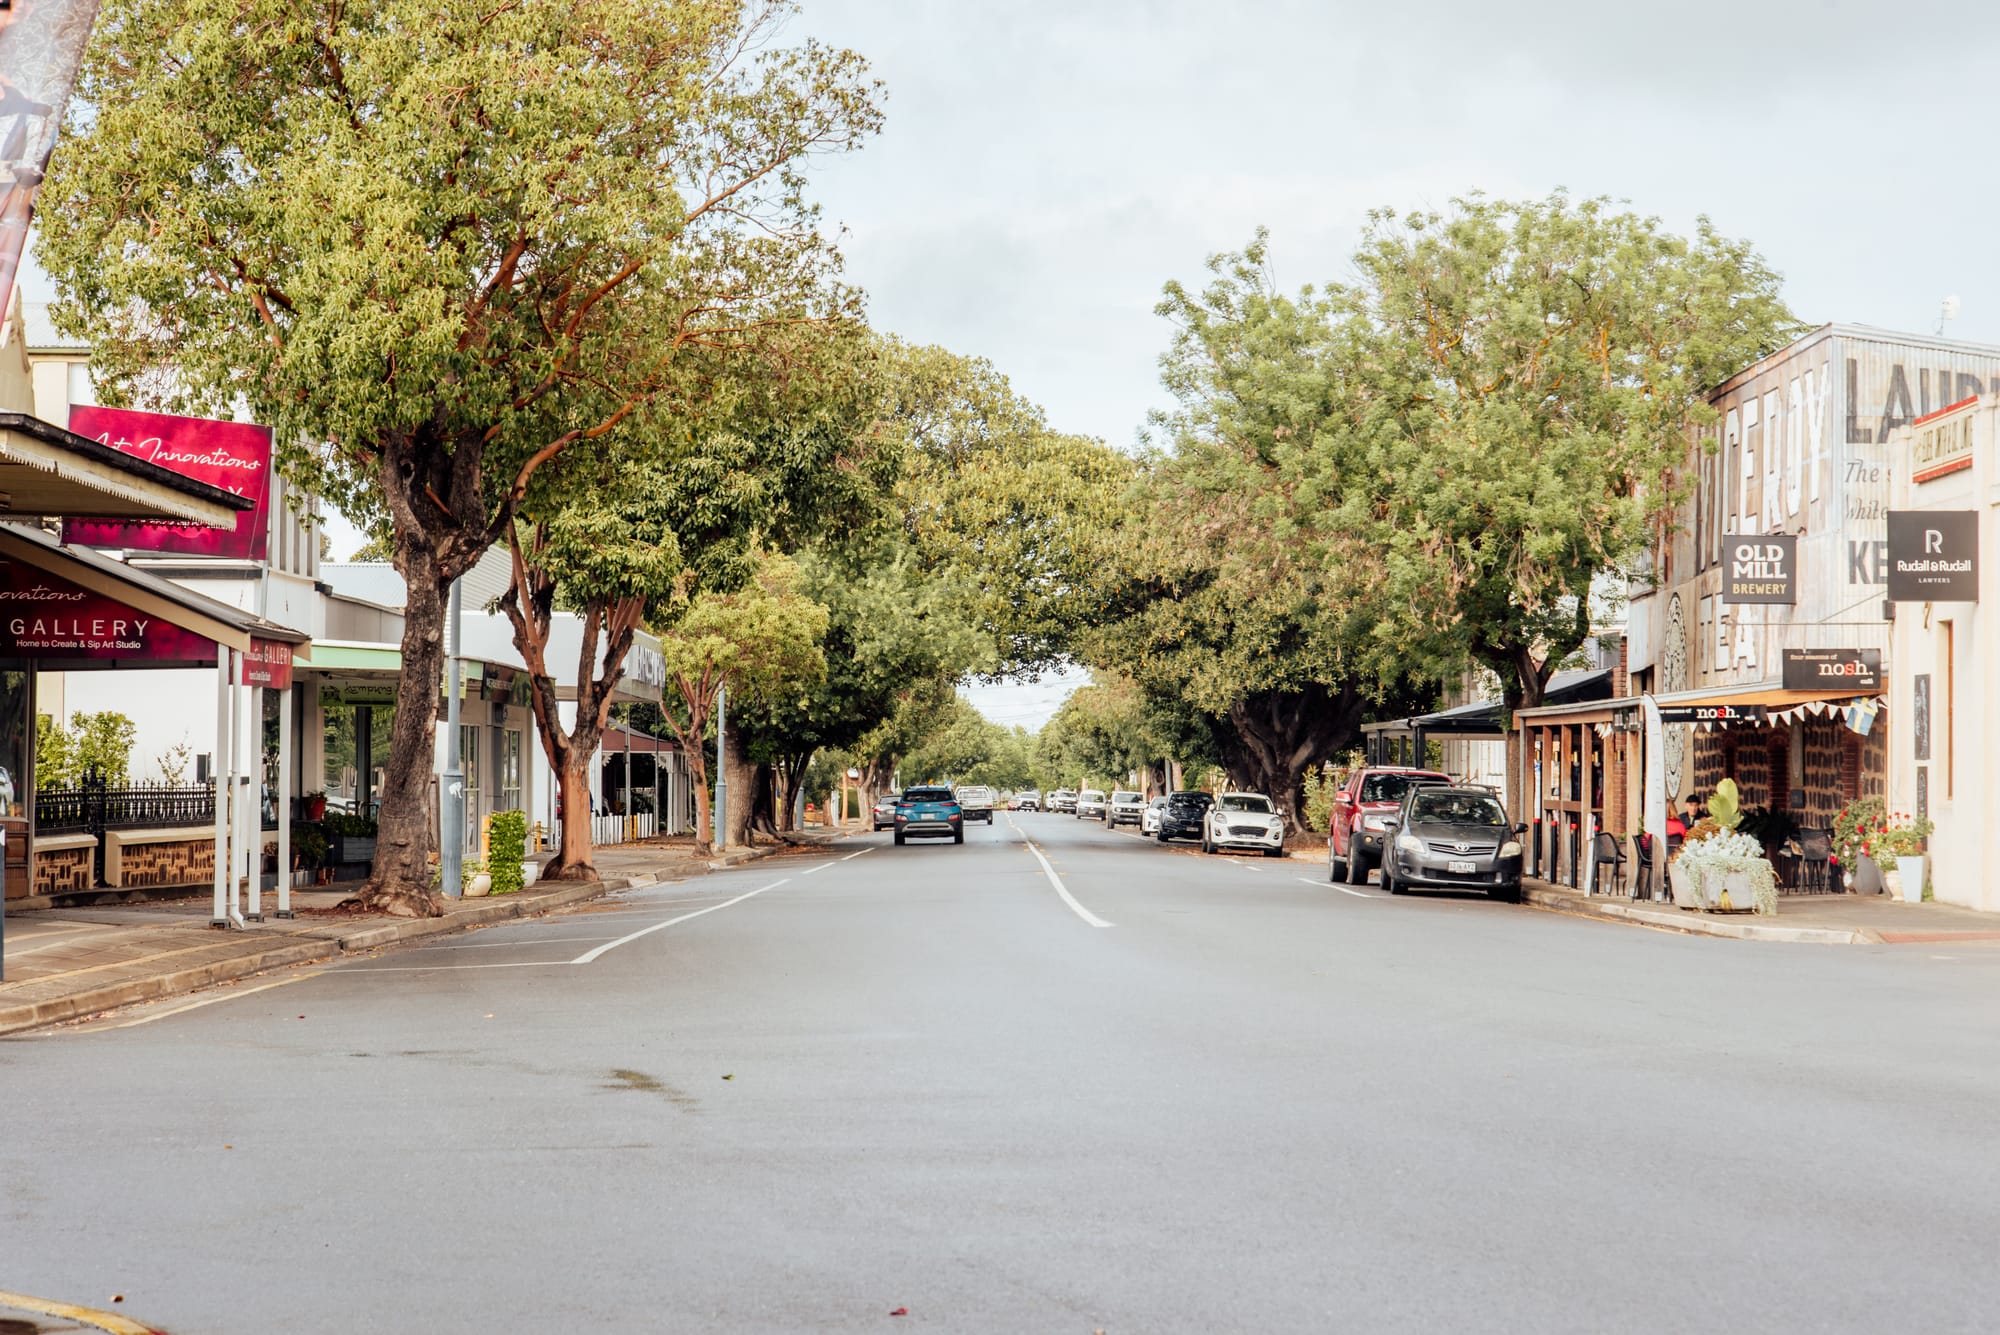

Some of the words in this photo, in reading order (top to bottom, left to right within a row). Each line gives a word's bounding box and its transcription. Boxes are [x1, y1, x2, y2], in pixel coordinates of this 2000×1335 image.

[139, 437, 261, 470] Innovations
[1845, 458, 1879, 482] The
[1925, 529, 1943, 553] R
[1735, 544, 1784, 562] OLD
[1732, 561, 1787, 579] MILL
[1897, 560, 1929, 571] Rudall
[1930, 561, 1938, 571] &
[1939, 560, 1971, 571] Rudall
[1732, 583, 1787, 594] BREWERY
[10, 618, 148, 636] GALLERY
[1699, 592, 1757, 674] TEA
[41, 640, 49, 648] to
[51, 640, 77, 648] Create
[79, 640, 85, 648] &
[87, 640, 101, 649] Sip
[102, 640, 114, 648] Art
[115, 641, 141, 649] Studio
[264, 645, 292, 664] GALLERY
[1818, 660, 1874, 676] nosh.
[1696, 706, 1740, 719] nosh.
